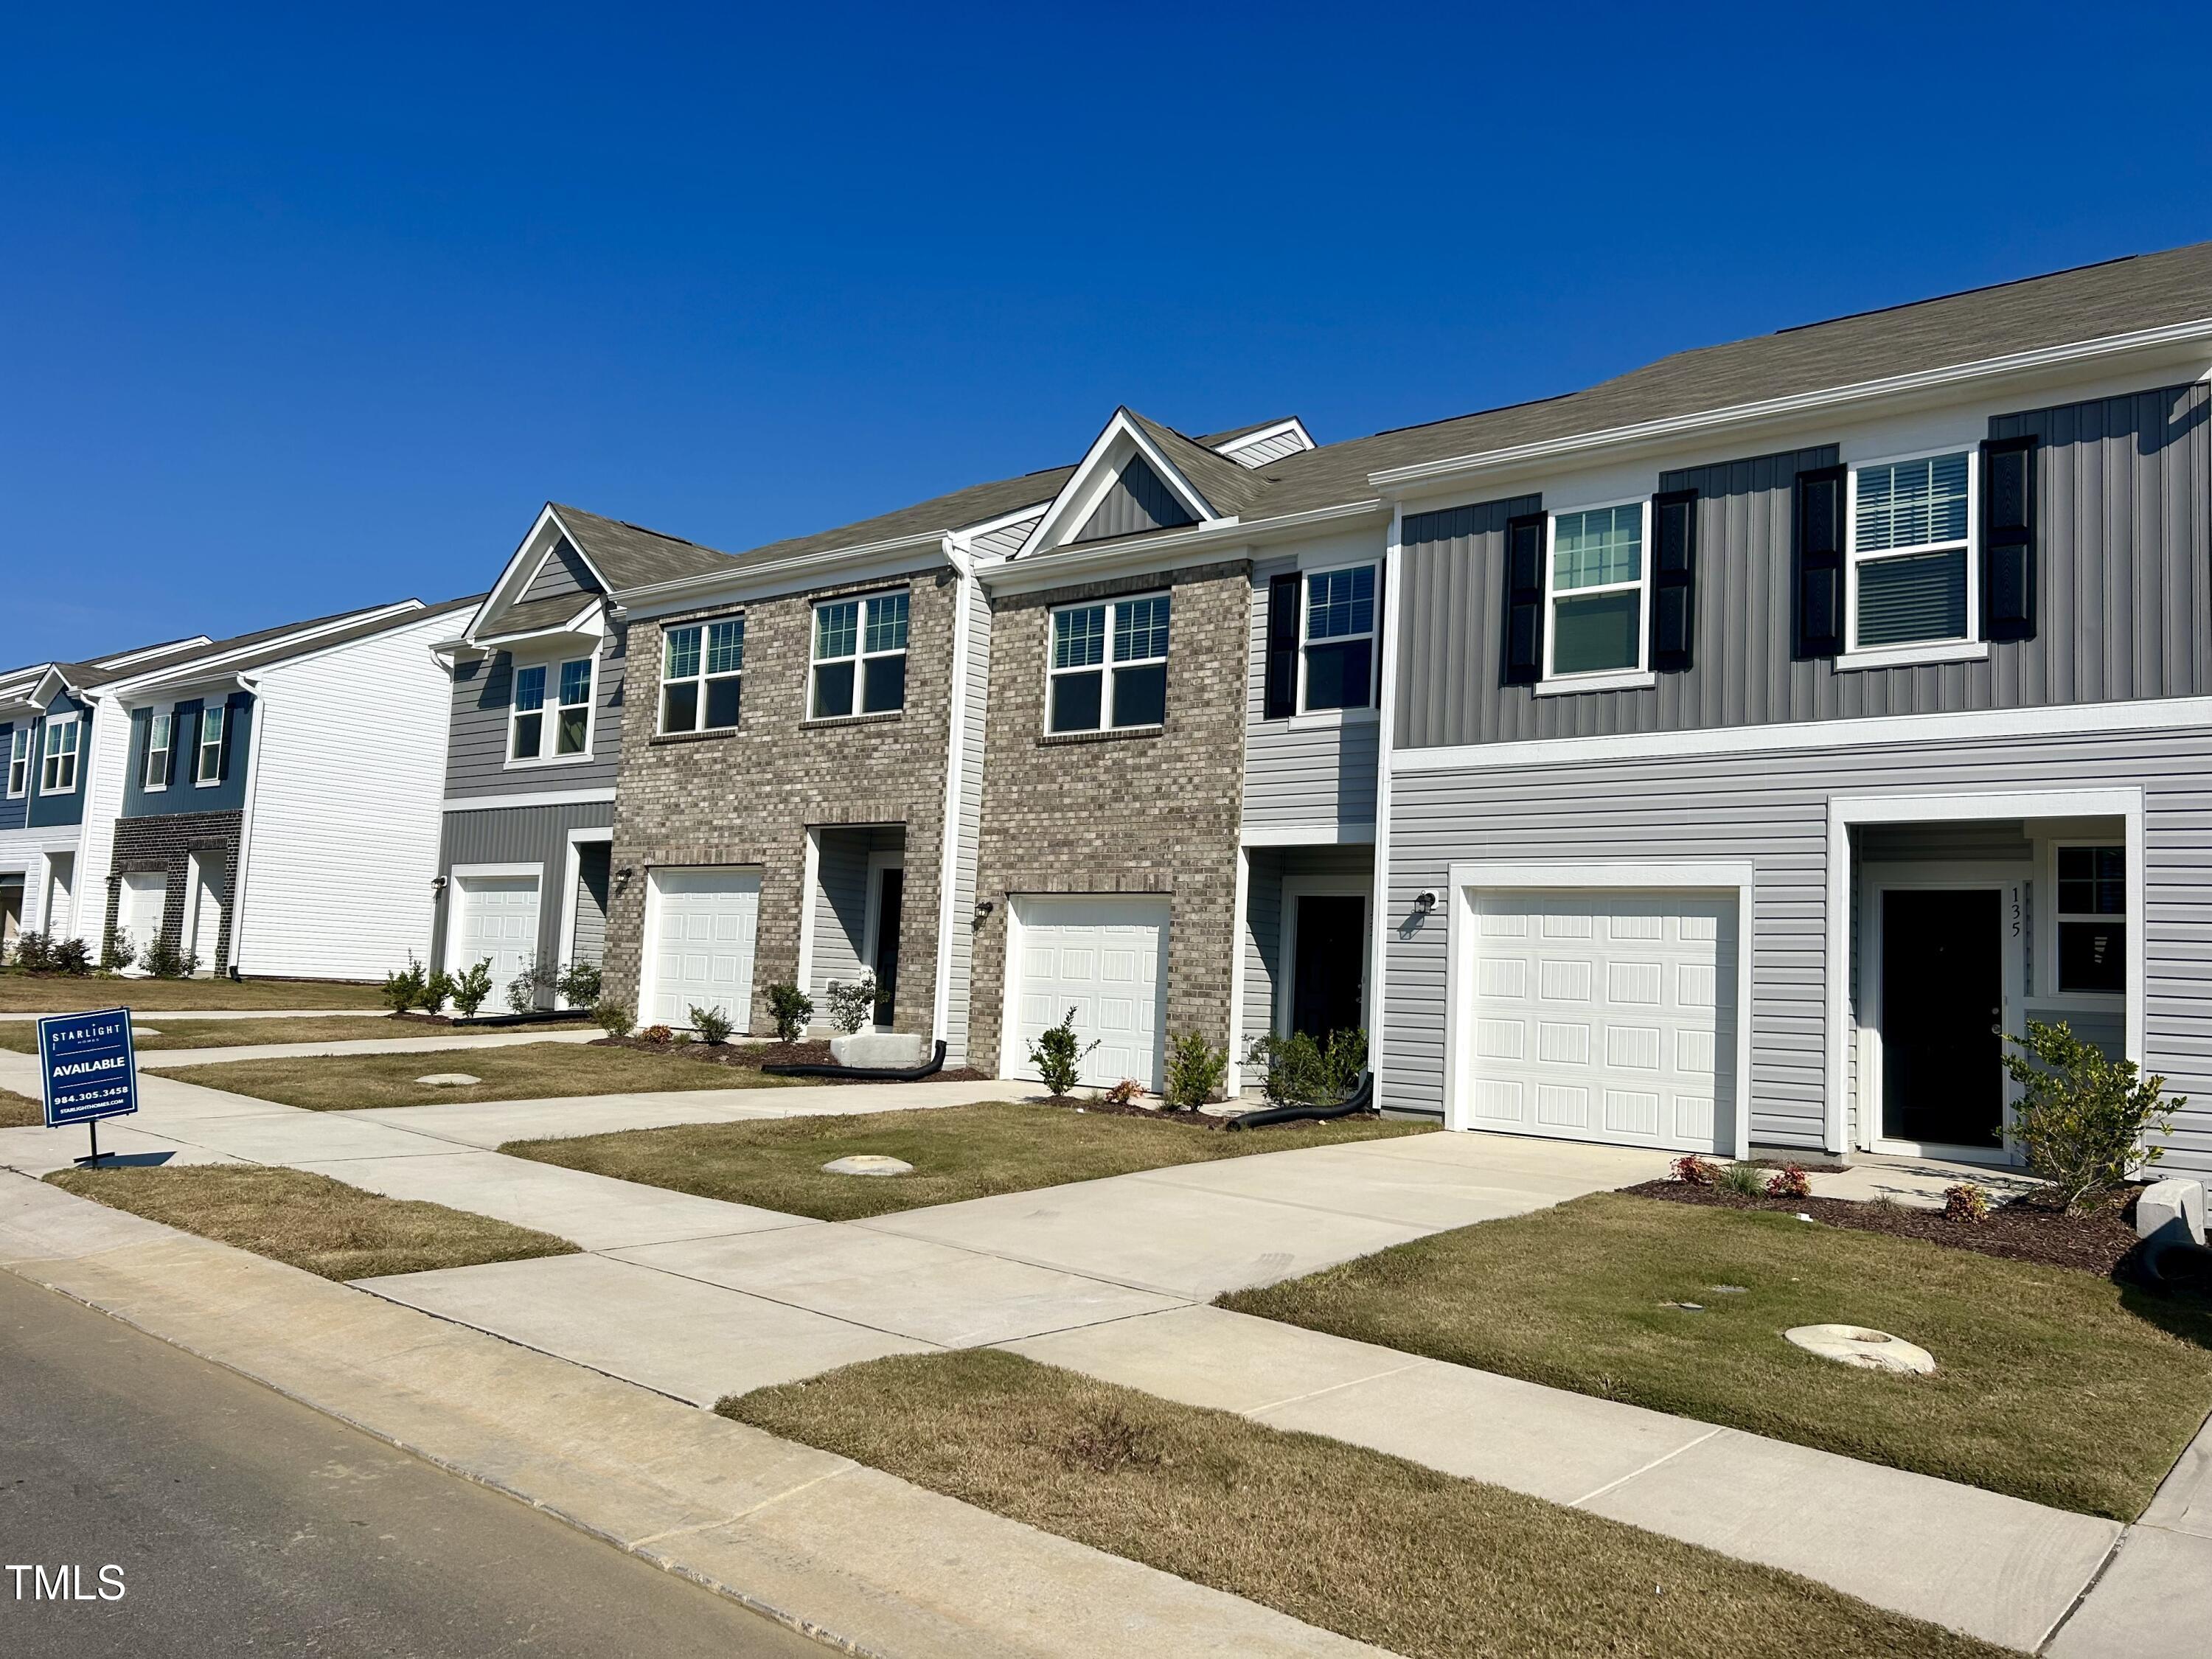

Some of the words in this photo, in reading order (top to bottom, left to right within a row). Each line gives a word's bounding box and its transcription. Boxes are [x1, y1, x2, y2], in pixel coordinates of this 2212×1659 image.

[2011, 887, 2020, 937] 135
[52, 1023, 120, 1042] STARLIGHT
[53, 1056, 125, 1077] AVAILABLE
[54, 1086, 128, 1105] 984.305.3458
[60, 1099, 124, 1114] STARLIGHTHOMES.COM
